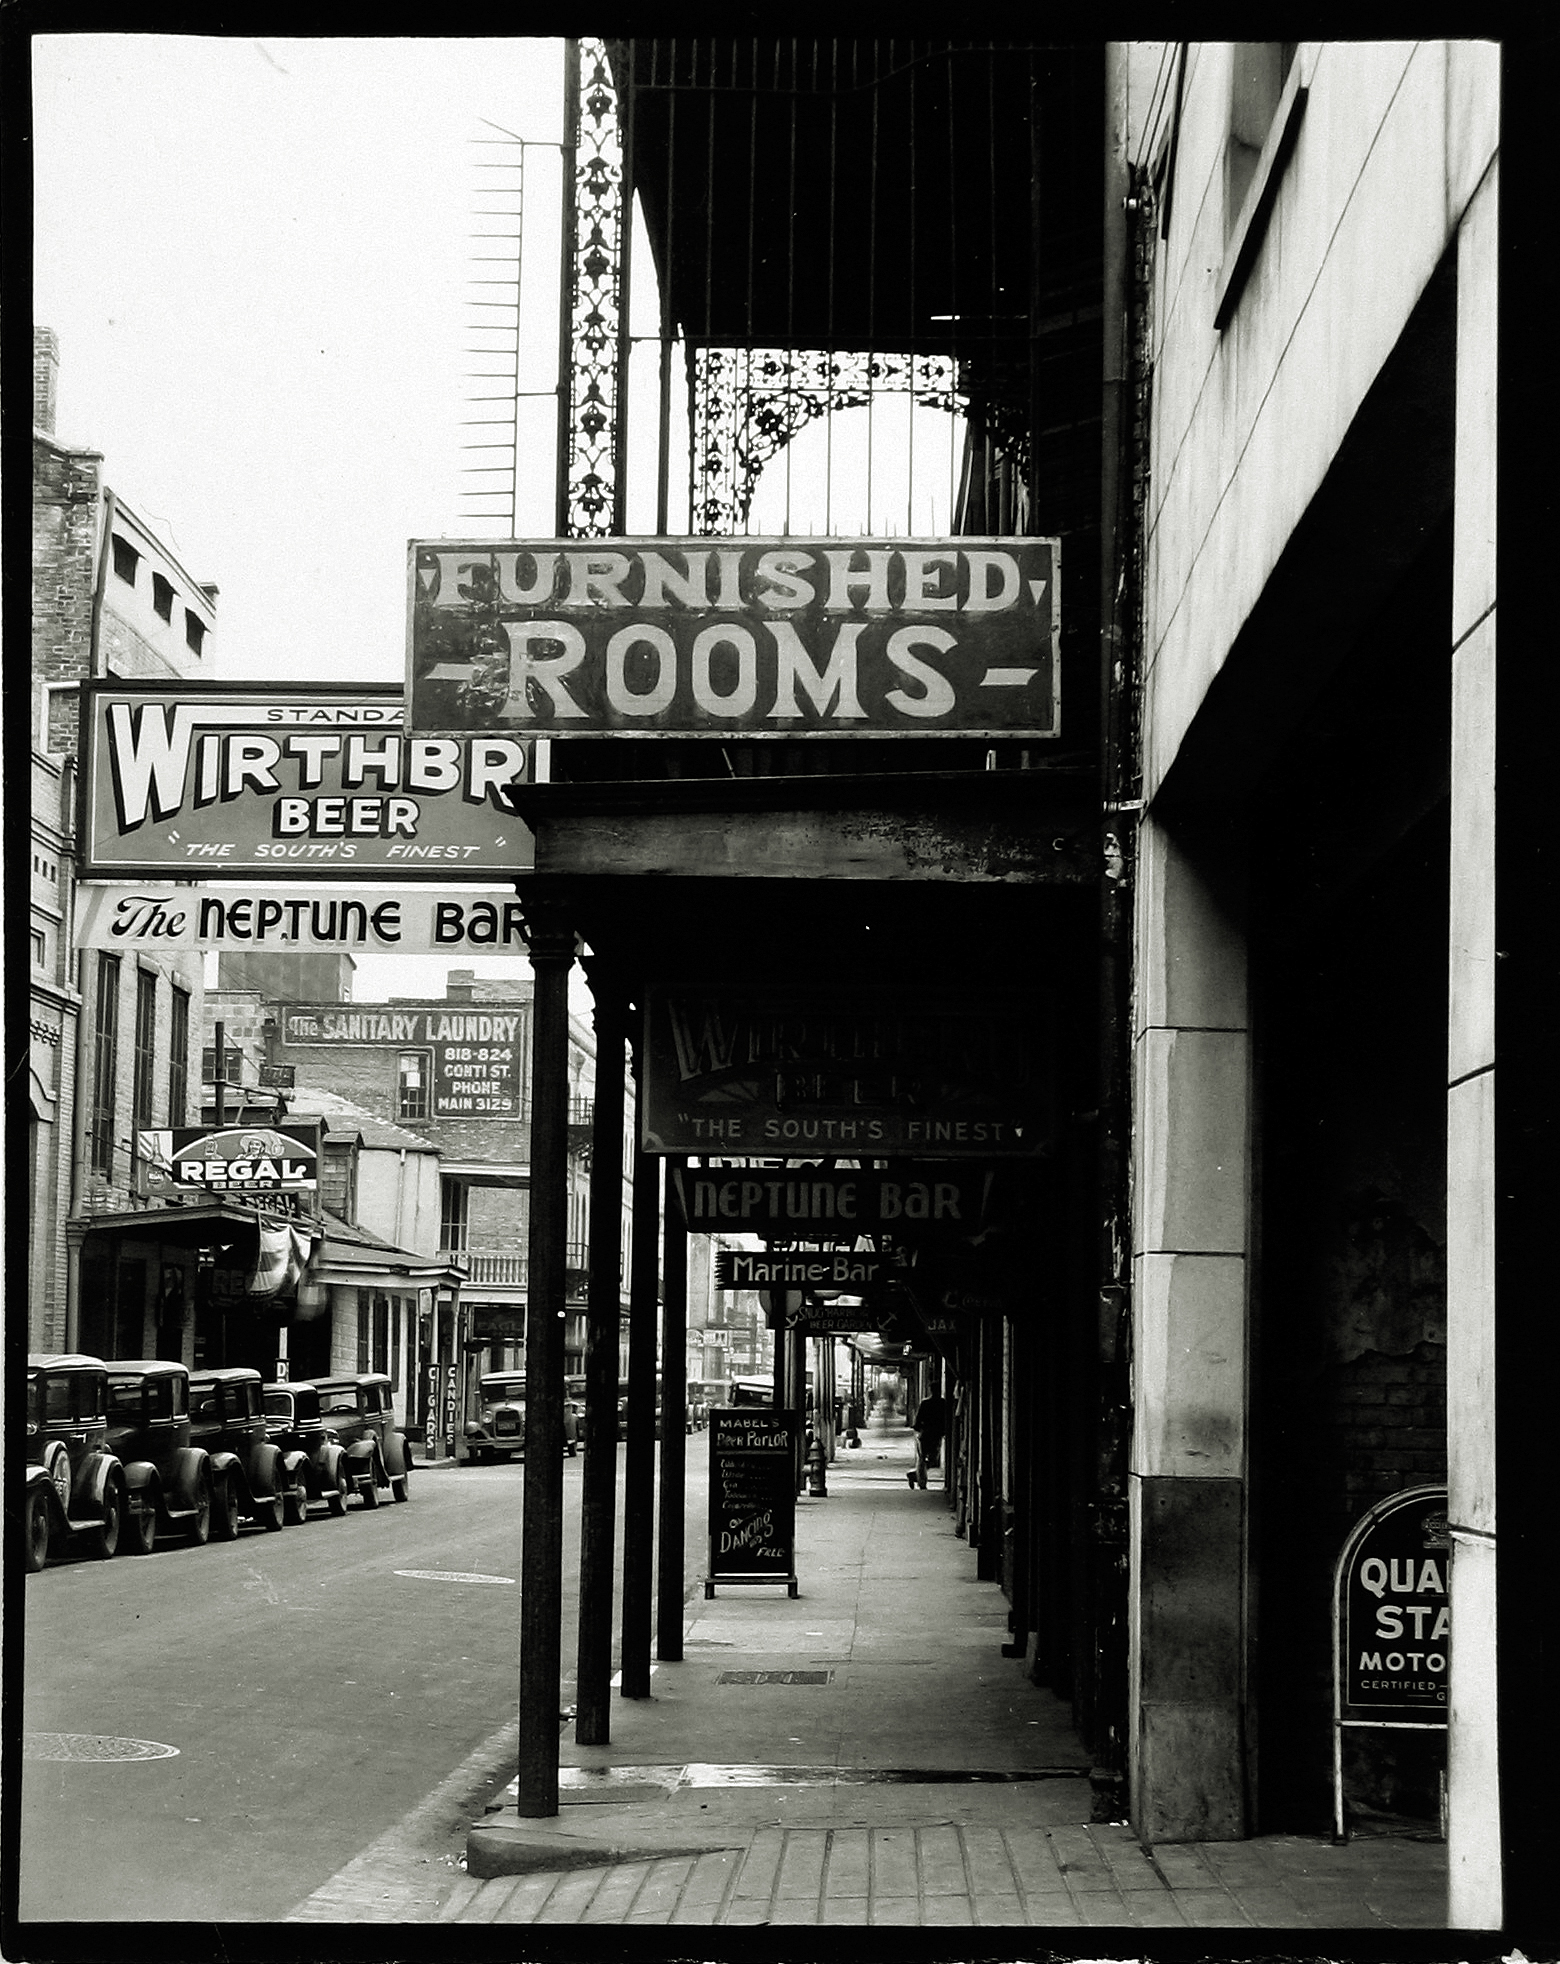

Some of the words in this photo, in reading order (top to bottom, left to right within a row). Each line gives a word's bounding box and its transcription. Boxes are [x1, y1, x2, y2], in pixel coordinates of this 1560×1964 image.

[437, 550, 1021, 610] FURNISHED
[497, 620, 960, 719] ROOMS
[273, 797, 420, 838] BEER
[254, 842, 358, 859] SOUTH'S
[111, 896, 188, 939] The
[322, 1014, 419, 1040] SANITARY
[426, 1015, 519, 1041] LAUNDRY
[444, 1047, 513, 1061] 818-824
[444, 1064, 487, 1078] CONTI
[490, 1064, 512, 1078] ST.
[452, 1081, 501, 1094] PHONE
[438, 1098, 472, 1110] MAIN
[764, 1119, 884, 1141] SOUTH'S
[181, 1160, 307, 1180] REGAL
[733, 1257, 823, 1281] Marine
[833, 1257, 880, 1281] Bar
[427, 1367, 437, 1449] CIGARS
[446, 1366, 456, 1446] CANDIES
[1360, 1557, 1449, 1598] QUA
[1360, 1680, 1436, 1690] CERTIFIED
